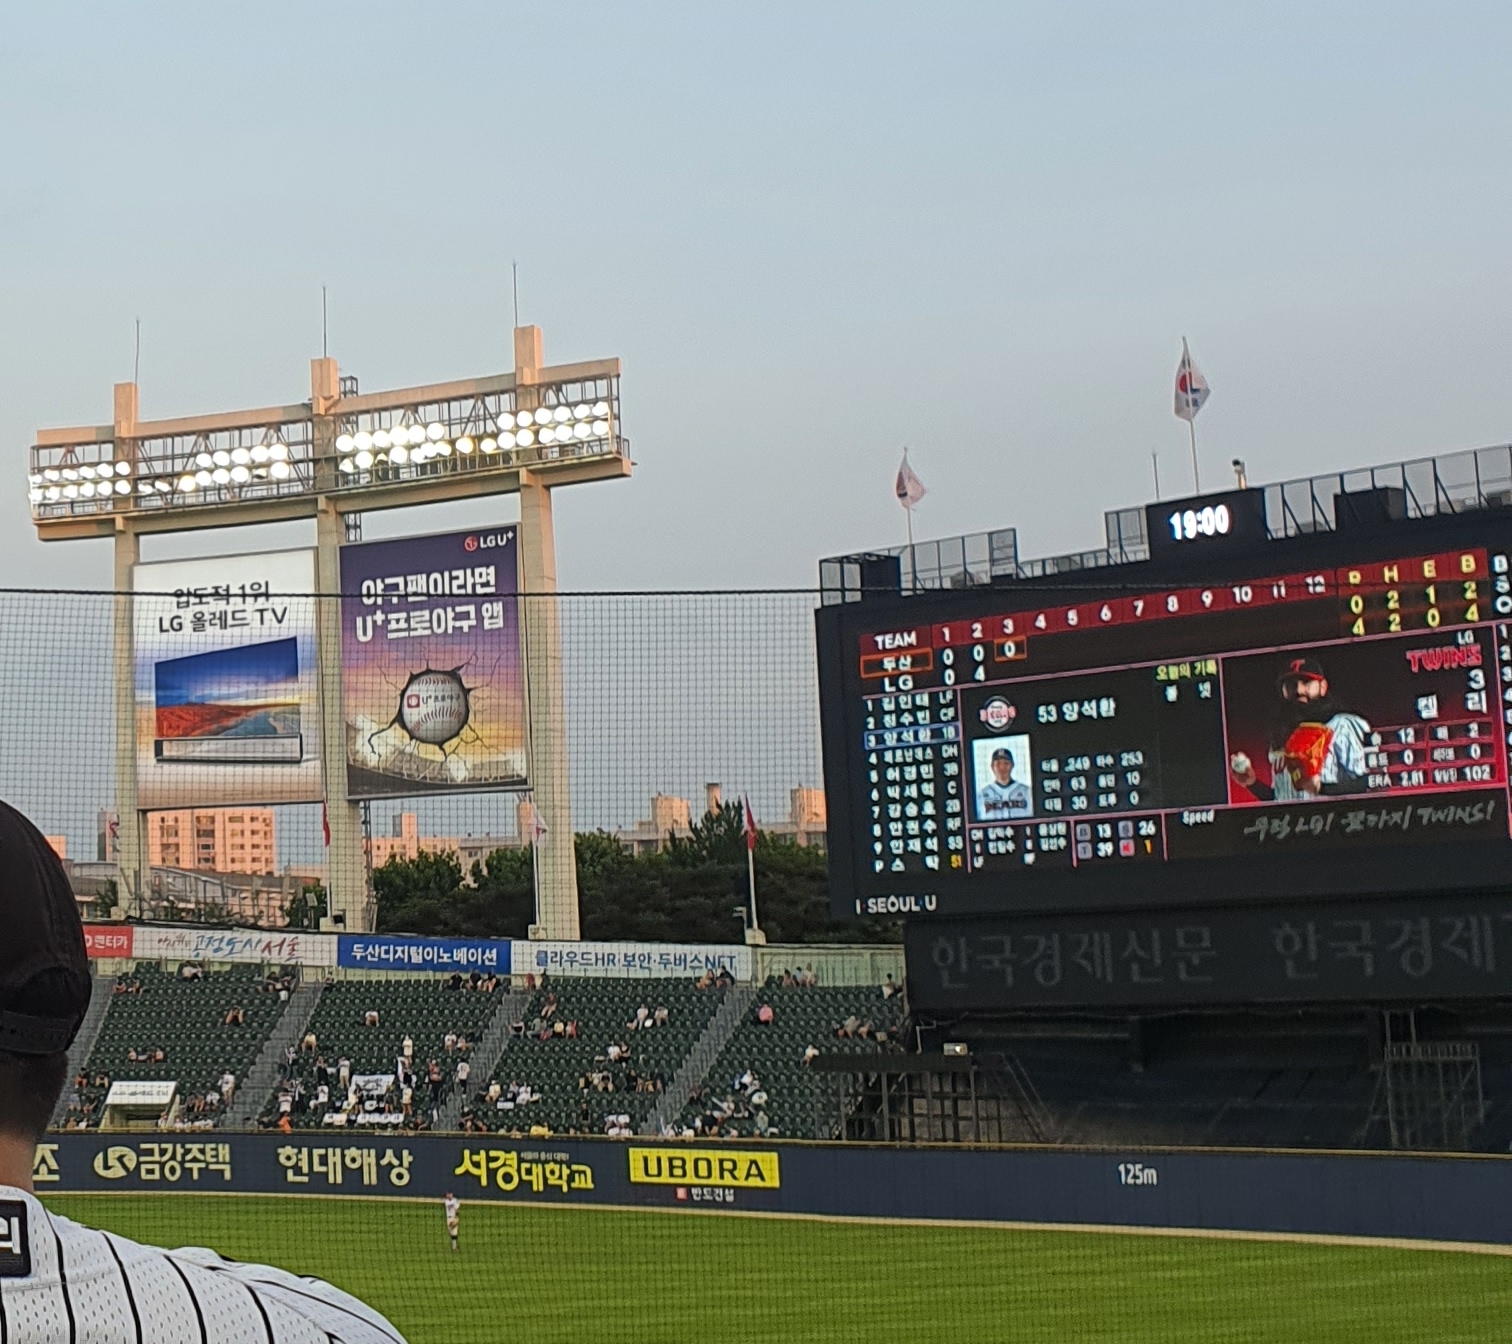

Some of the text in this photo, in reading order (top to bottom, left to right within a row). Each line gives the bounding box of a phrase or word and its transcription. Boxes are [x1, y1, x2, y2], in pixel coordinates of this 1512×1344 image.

[1170, 505, 1229, 540] 19:00
[480, 535, 496, 549] LG
[1384, 565, 1398, 583] H
[1423, 560, 1436, 578] E
[1460, 554, 1475, 573] B
[173, 581, 270, 609] 압도적 1위
[361, 566, 495, 606] 야구팬이라면
[159, 606, 288, 634] LG 올레드 TV
[481, 601, 504, 629] 앱
[942, 575, 1326, 642] 1 2 3 4 5 6 7 8 9 10 11 12
[943, 648, 954, 665] 0
[973, 645, 984, 661] 0
[1004, 641, 1015, 657] 0
[1350, 595, 1363, 614] 0
[1387, 590, 1399, 610] 2
[1426, 585, 1436, 604] 1
[1464, 580, 1477, 599] 2
[875, 631, 917, 650] TEAM
[883, 603, 1479, 692] LG 0 4 4 2 0 4
[1456, 630, 1474, 646] LG
[1406, 643, 1482, 674] TWINS
[1468, 668, 1486, 690] 3
[1037, 705, 1057, 723] 53
[1397, 727, 1415, 744] 12
[1468, 722, 1479, 738] 2
[1403, 749, 1414, 765] 0
[1470, 743, 1481, 760] 0
[1126, 771, 1140, 787] 10
[1463, 764, 1492, 782] 102
[1130, 790, 1140, 806] 0
[1096, 824, 1112, 839] 13
[1138, 820, 1155, 836] 26
[1182, 809, 1215, 827] Speed
[1097, 842, 1113, 857] 39
[351, 942, 498, 968] 두산디지털이노베이션
[930, 924, 1217, 990] 한국경제신문
[1273, 910, 1512, 981] 한국경제
[139, 1143, 232, 1182] 금강주택
[278, 1145, 414, 1187] 현대해상
[454, 1148, 595, 1193] 서경대학교
[643, 1155, 767, 1182] UBORA
[1118, 1163, 1158, 1186] 125m
